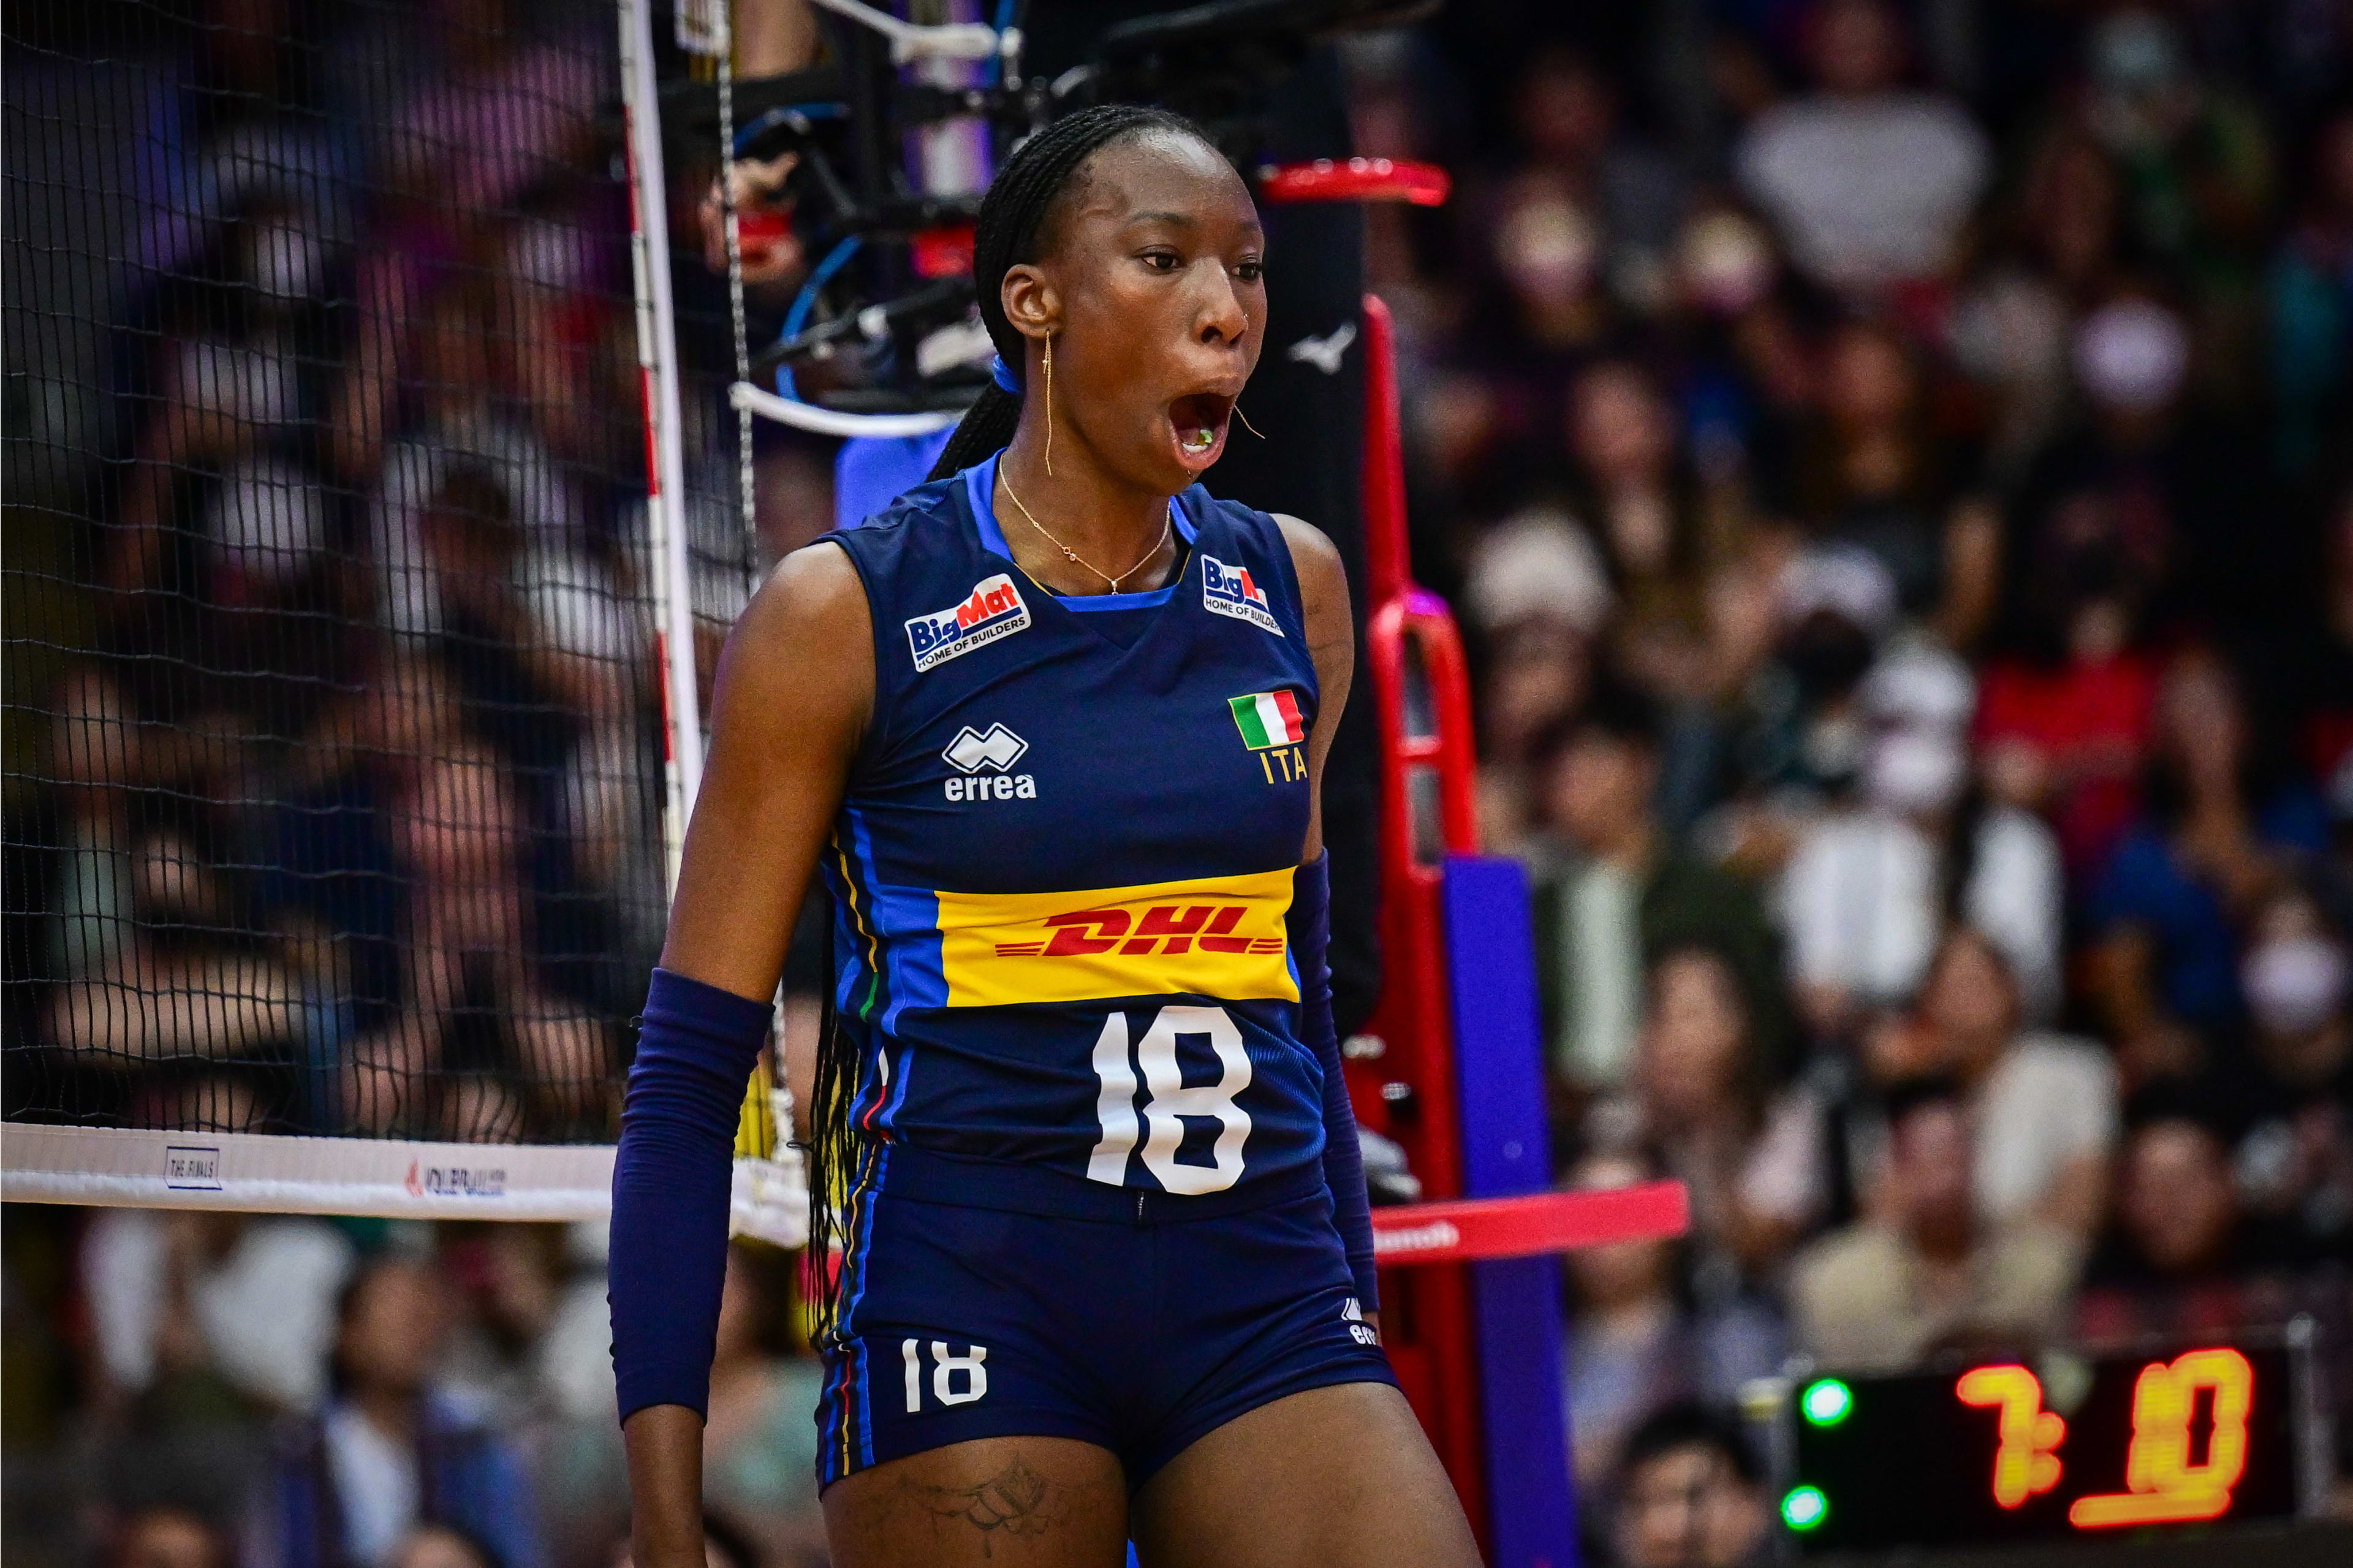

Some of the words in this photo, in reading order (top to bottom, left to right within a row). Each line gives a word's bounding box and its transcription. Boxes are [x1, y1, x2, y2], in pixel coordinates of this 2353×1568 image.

[908, 583, 1018, 653] BigMat
[1206, 598, 1233, 613] HOME
[1236, 606, 1249, 615] OF
[919, 647, 952, 668] HOME
[953, 640, 969, 652] OF
[971, 616, 1026, 645] BUILDERS
[944, 775, 1037, 801] errea
[1259, 747, 1308, 784] ITA
[1042, 906, 1252, 957] DHL
[1086, 1006, 1252, 1195] 18
[171, 1159, 185, 1177] THE
[902, 1338, 987, 1413] 18
